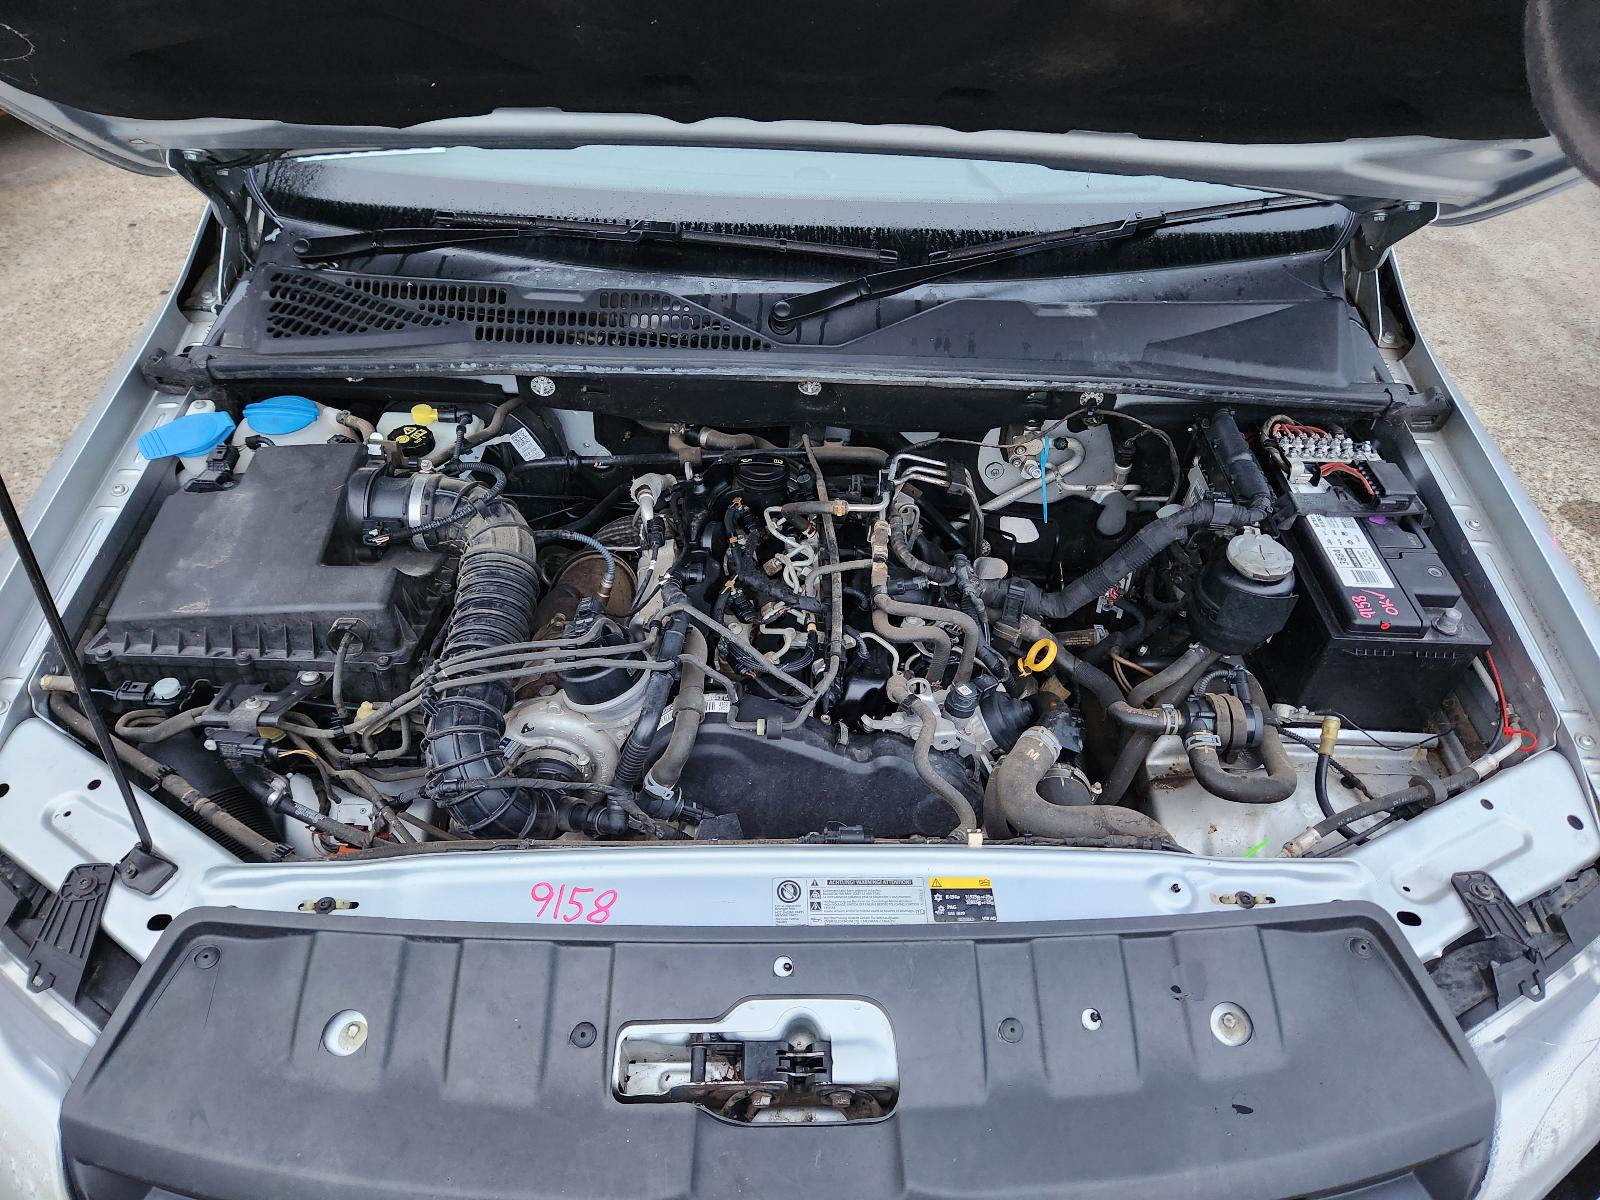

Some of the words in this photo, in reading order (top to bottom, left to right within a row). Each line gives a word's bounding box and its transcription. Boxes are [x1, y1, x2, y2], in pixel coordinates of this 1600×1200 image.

[1351, 595, 1375, 618] 9158
[1379, 598, 1399, 615] OK
[531, 881, 618, 924] 9158
